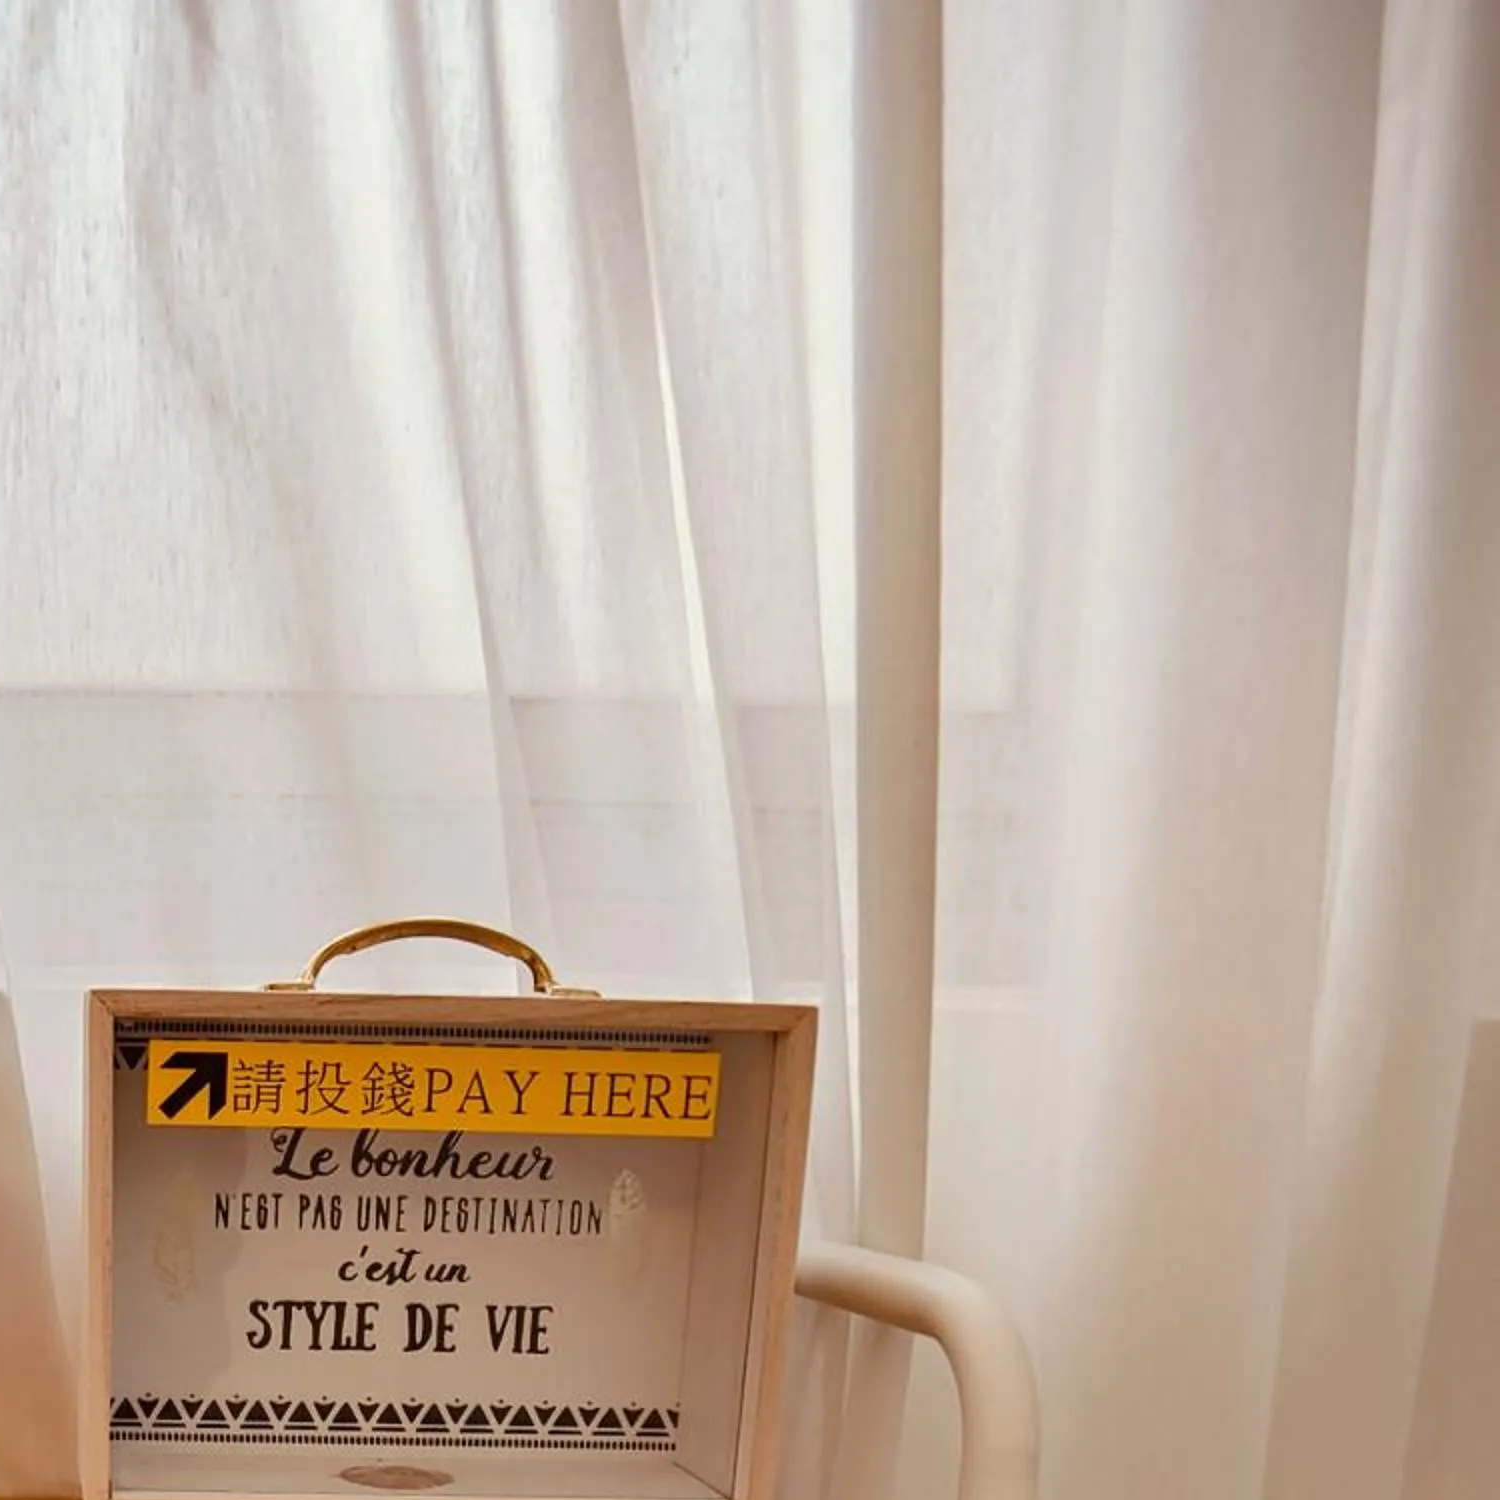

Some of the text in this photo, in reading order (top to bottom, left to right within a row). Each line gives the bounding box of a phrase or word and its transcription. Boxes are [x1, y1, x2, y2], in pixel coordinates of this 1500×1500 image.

[232, 1058, 714, 1121] 請投錢 PAY HERE
[270, 1126, 555, 1182] Le bonheur
[299, 1193, 343, 1232] PAS
[356, 1195, 409, 1234] UNE
[423, 1197, 603, 1236] DESTINATION
[337, 1245, 472, 1286] c'est un
[245, 1300, 554, 1355] STYLE DE VIE
